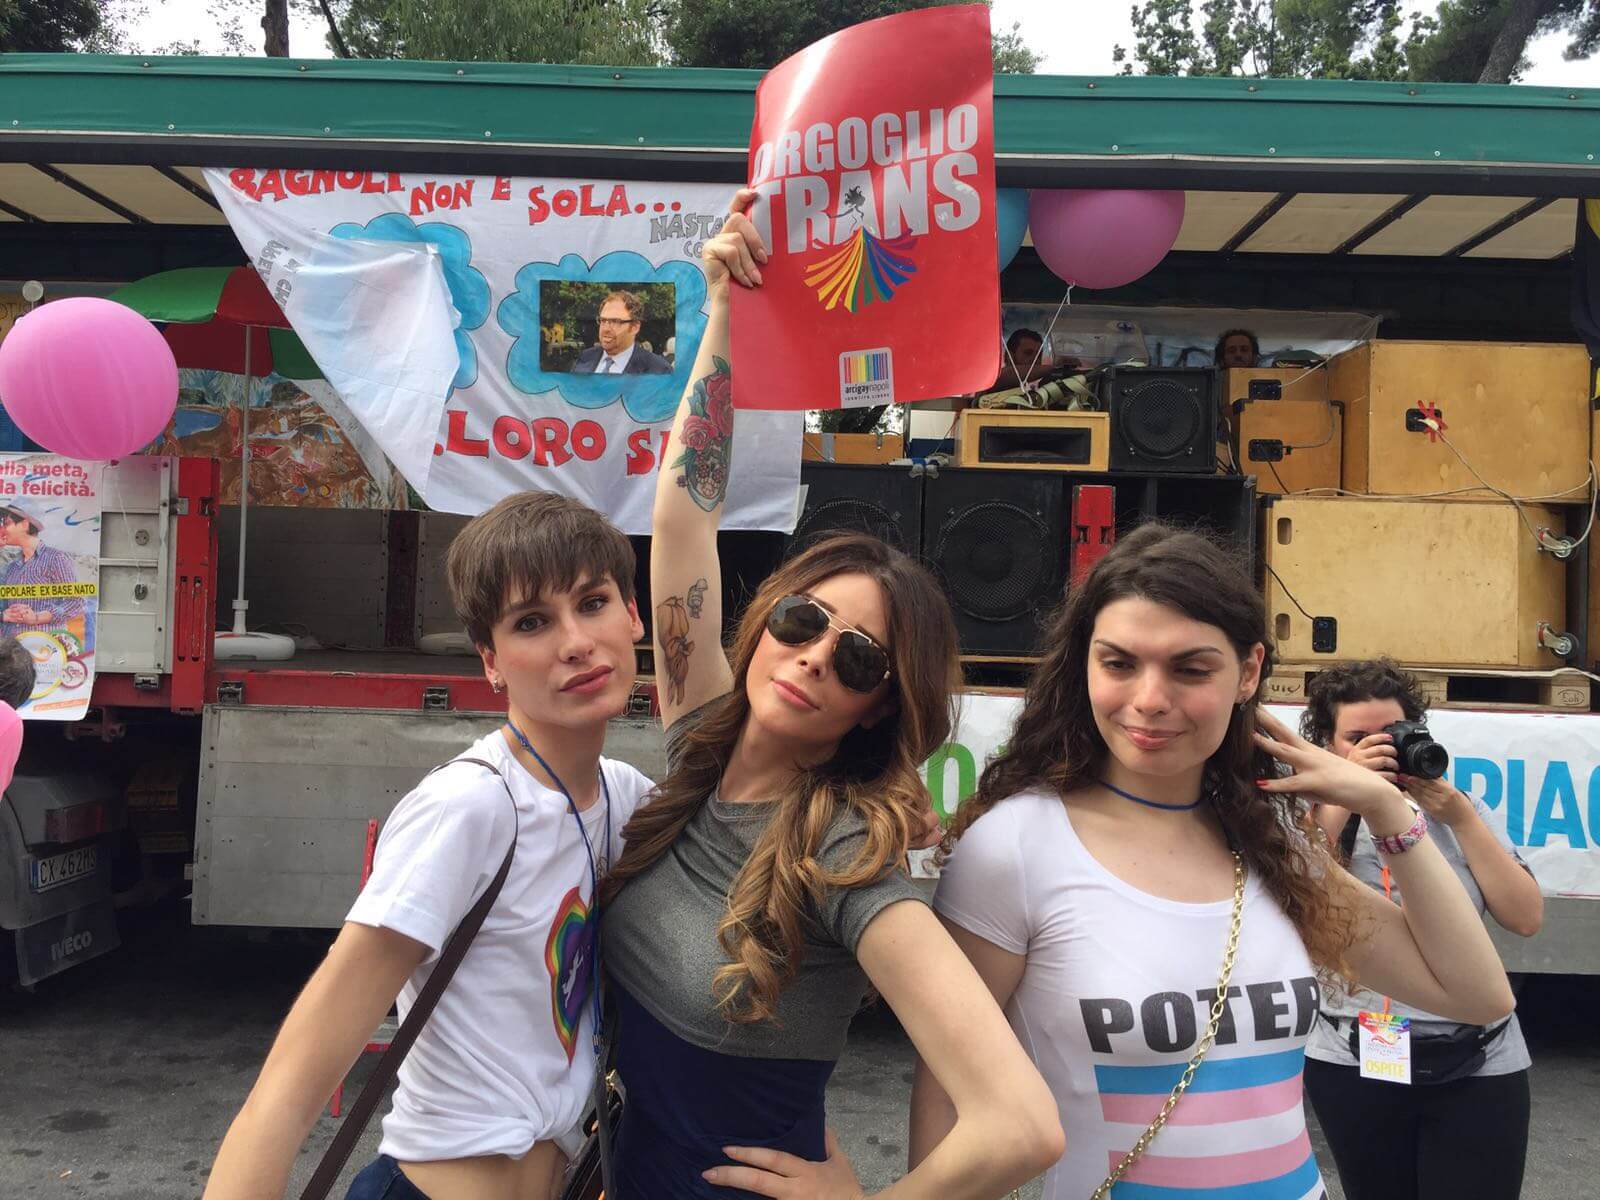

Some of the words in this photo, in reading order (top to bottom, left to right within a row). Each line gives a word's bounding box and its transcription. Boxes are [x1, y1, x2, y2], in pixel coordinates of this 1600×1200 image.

[752, 104, 978, 186] ORGOGLIO
[409, 180, 475, 215] NON
[528, 184, 682, 226] SOLA...
[750, 152, 981, 256] TRANS
[650, 211, 730, 243] NASTA
[33, 464, 88, 480] meta,
[40, 585, 50, 596] EX
[52, 585, 72, 595] BASE
[74, 584, 96, 595] NATO
[40, 860, 56, 884] CX
[51, 930, 92, 961] IVECO
[1079, 976, 1321, 1054] POTER
[1365, 1059, 1405, 1078] OSPITE
